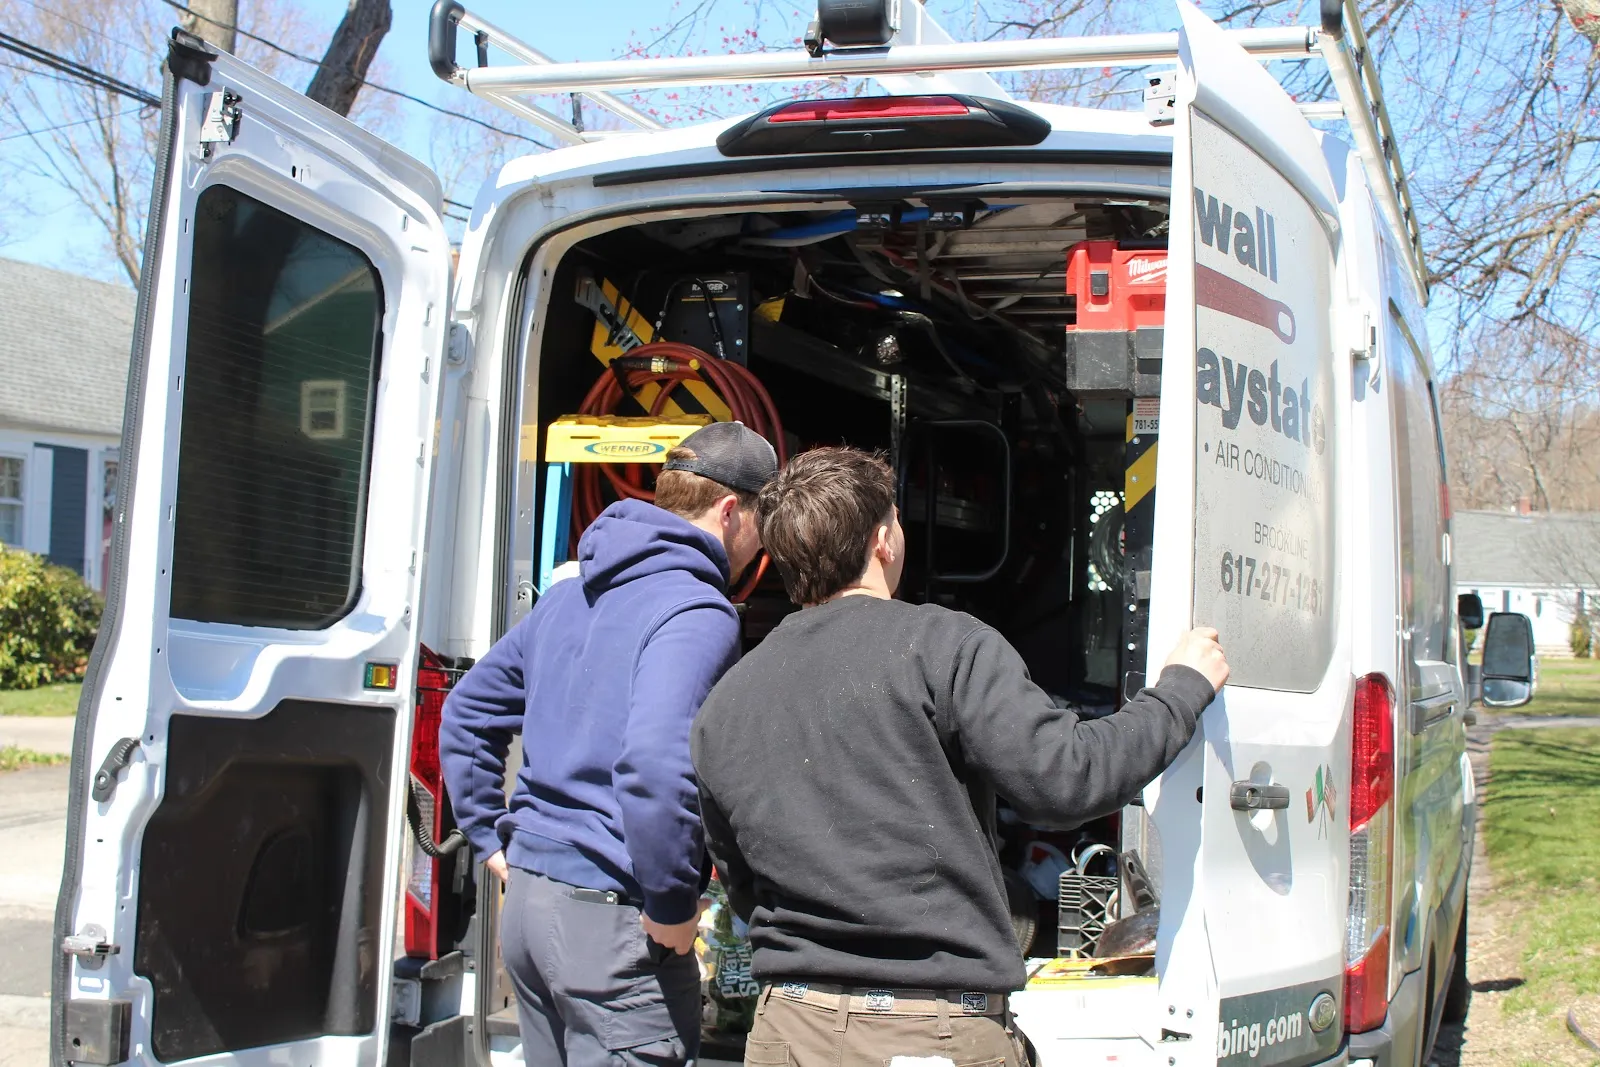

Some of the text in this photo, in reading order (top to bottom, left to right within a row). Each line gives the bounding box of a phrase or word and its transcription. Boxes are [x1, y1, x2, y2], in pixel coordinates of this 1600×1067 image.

[1194, 186, 1278, 284] wall
[600, 445, 650, 453] WERNER
[1215, 440, 1240, 472] AIR
[1254, 521, 1309, 560] BROOKLINE
[1217, 1011, 1302, 1059] bing.com
